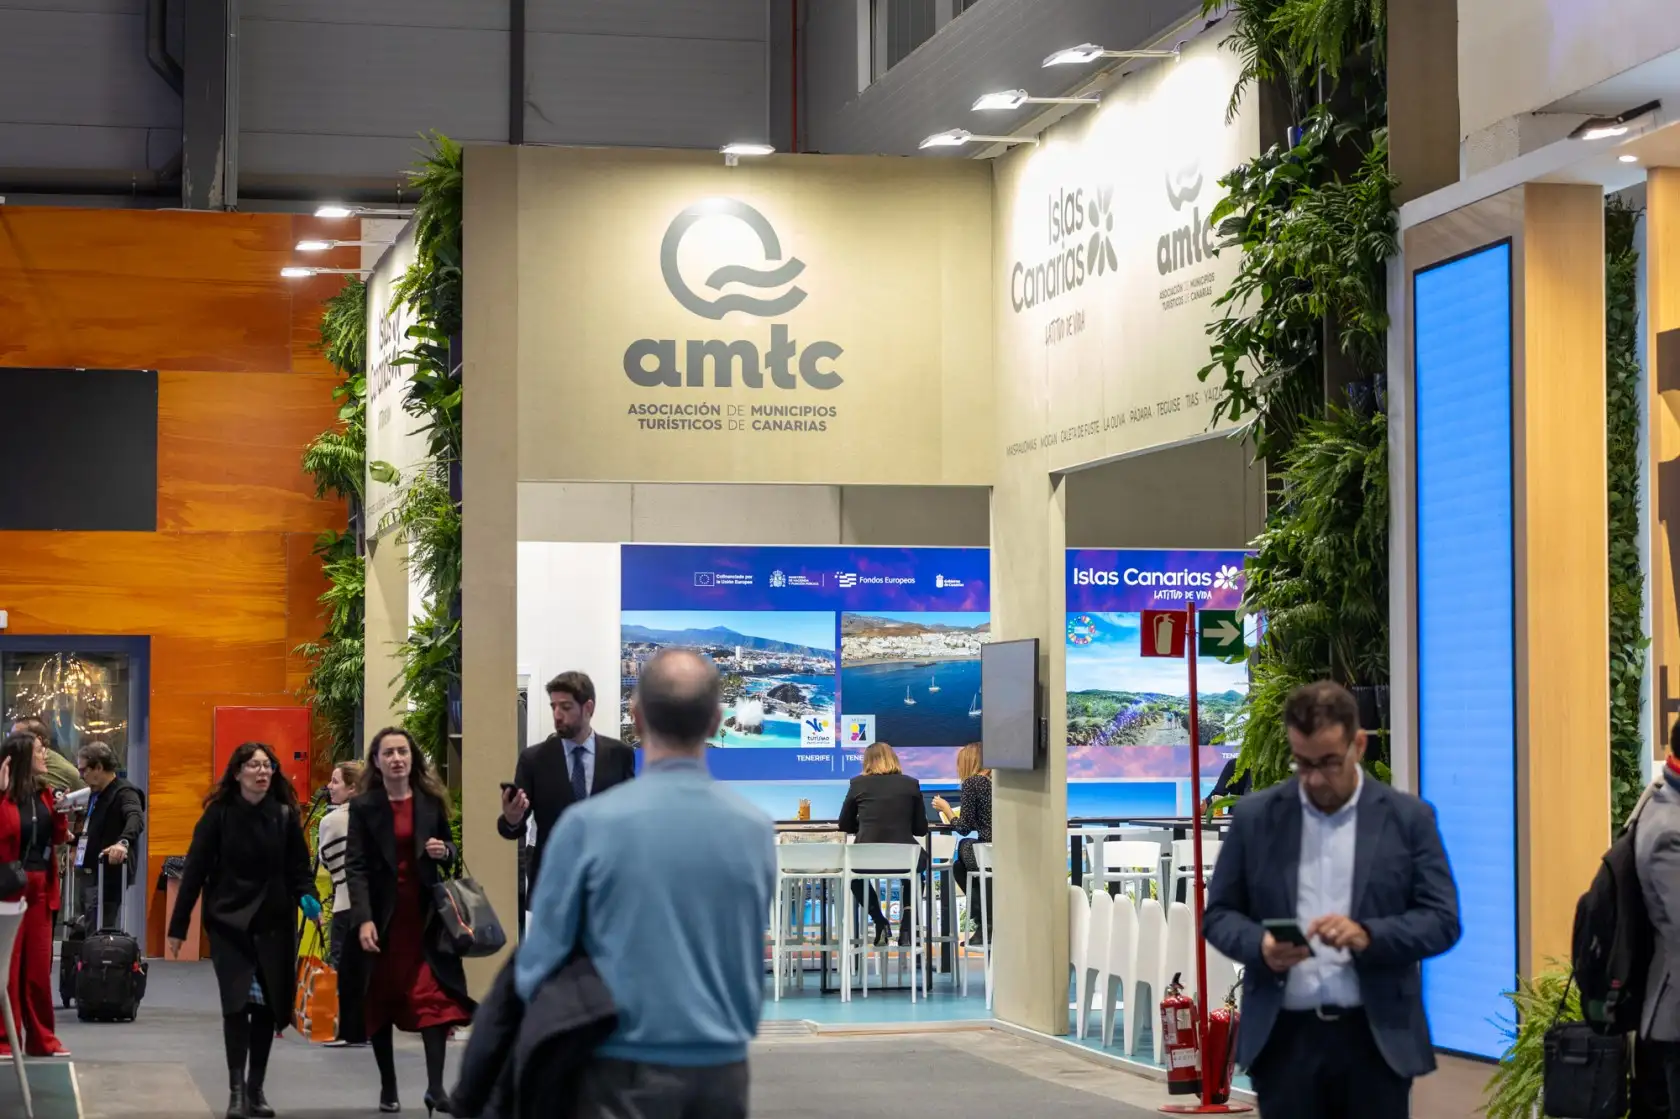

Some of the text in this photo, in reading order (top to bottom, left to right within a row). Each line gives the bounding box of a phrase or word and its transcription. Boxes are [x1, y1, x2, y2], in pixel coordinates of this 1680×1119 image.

[1048, 187, 1084, 246] Islas
[1011, 239, 1085, 313] Canarias
[622, 324, 845, 391] amtc
[628, 402, 838, 418] ASOCIACIÓN DE MUNICIPIOS
[638, 418, 828, 432] TURÍSTICOS DE CANARIAS
[859, 576, 916, 586] Fondos Europeos
[1073, 567, 1212, 586] Islas Canarias
[1184, 590, 1194, 600] DE
[796, 754, 831, 762] TENERIFE
